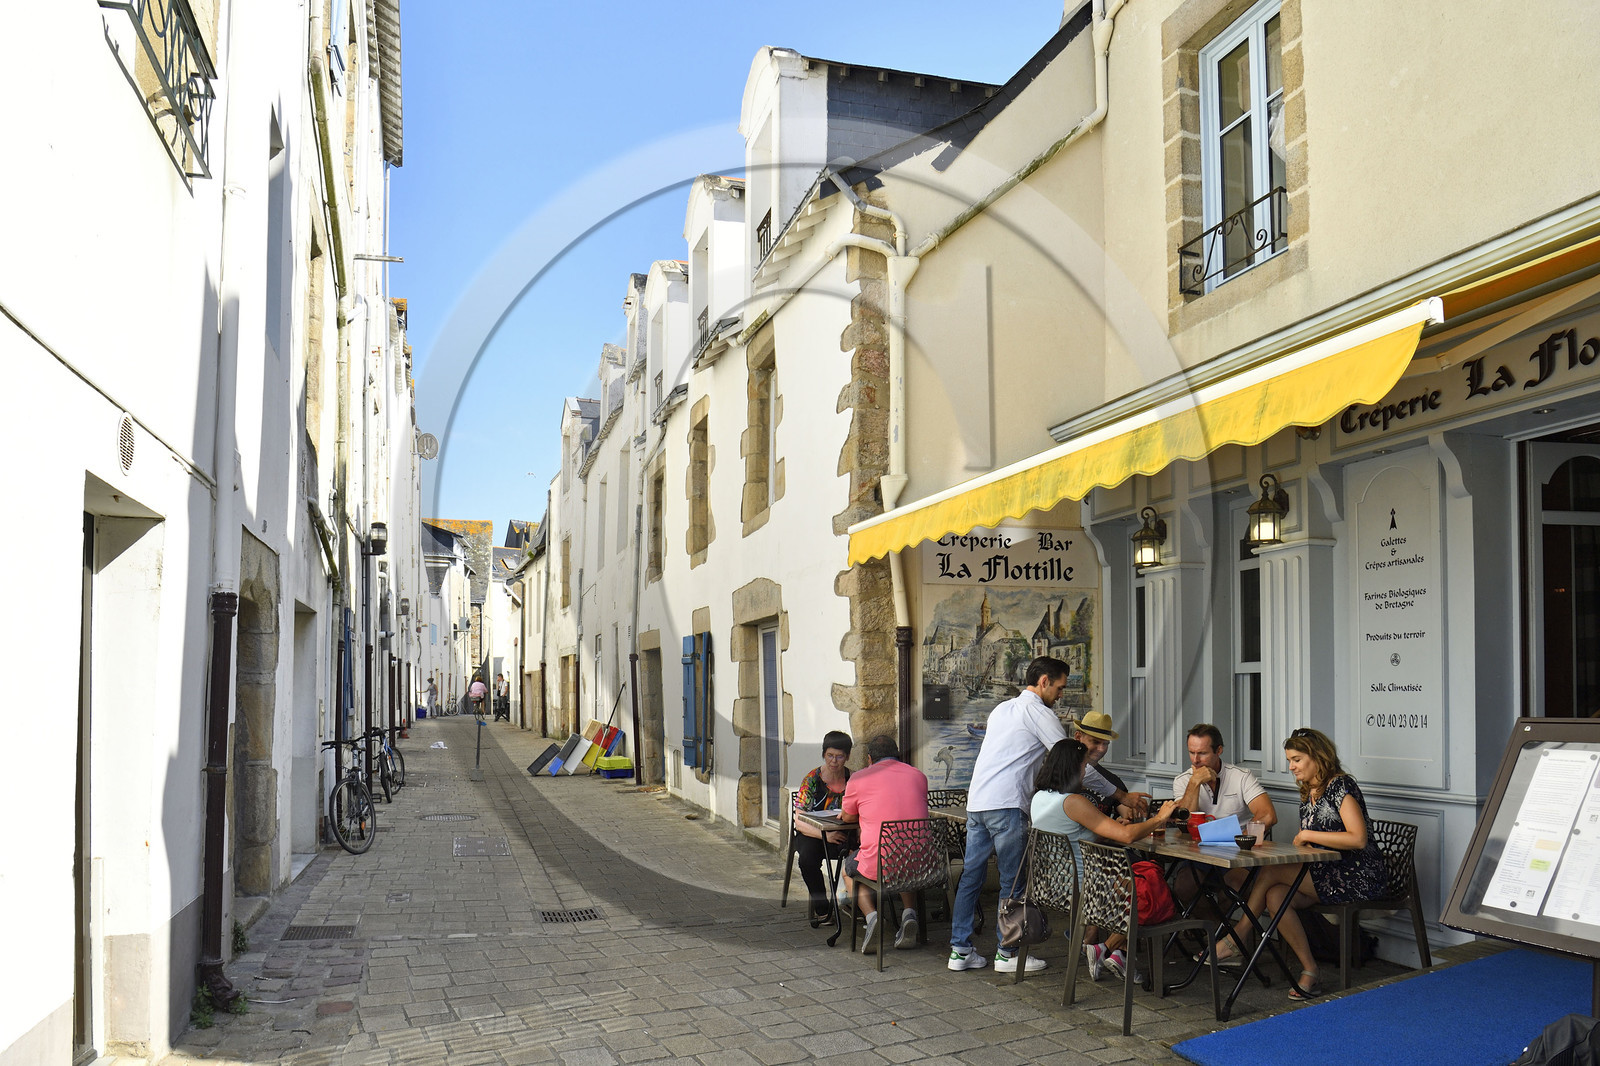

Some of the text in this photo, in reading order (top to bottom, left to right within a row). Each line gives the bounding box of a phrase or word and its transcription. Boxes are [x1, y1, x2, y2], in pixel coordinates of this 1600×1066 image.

[1462, 356, 1515, 400] La
[1038, 532, 1073, 553] Bar
[1380, 537, 1407, 547] Galettes
[1387, 554, 1425, 567] artisanales
[936, 552, 1074, 583] La Flottille
[1364, 588, 1427, 601] Farines Biologiques
[1375, 600, 1414, 610] de Bretagne
[1366, 630, 1425, 641] Produits du terroir
[1370, 683, 1386, 692] Salle
[1376, 713, 1386, 728] 02
[1387, 713, 1397, 728] 40
[1408, 714, 1419, 728] 02
